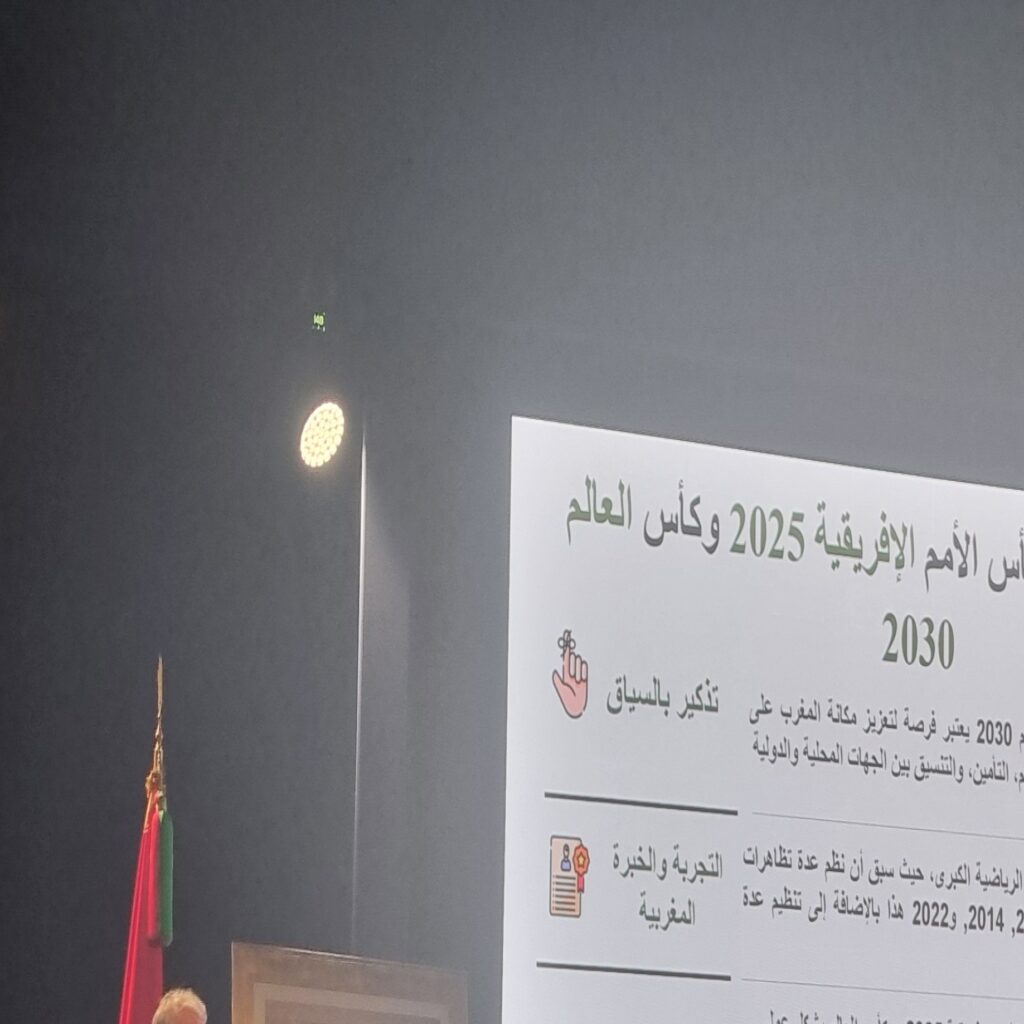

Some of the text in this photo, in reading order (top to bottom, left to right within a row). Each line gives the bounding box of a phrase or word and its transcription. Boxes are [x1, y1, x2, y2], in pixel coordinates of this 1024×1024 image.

[567, 474, 632, 544] العالم
[642, 480, 721, 555] وكأس
[729, 503, 805, 562] 2025
[814, 501, 914, 582] الإفريقية
[924, 520, 977, 592] الأمم
[882, 613, 954, 670] 2030
[607, 674, 718, 720] تذكير بالسياق
[749, 693, 773, 725] على
[780, 698, 821, 726] المغرب
[827, 698, 857, 725] مكانة
[862, 709, 898, 735] لتعزيز
[903, 707, 936, 741] فرصة
[942, 718, 970, 743] يعتبر
[976, 719, 1012, 746] 2030
[753, 730, 799, 767] والدولية
[803, 736, 843, 767] المحلية
[848, 746, 887, 775] الجهات
[891, 754, 910, 778] بين
[914, 754, 964, 784] والتنسيق
[969, 755, 1009, 786] التأمين،
[613, 843, 722, 884] التجربة والخبرة
[743, 844, 792, 873] تظاهرات
[798, 849, 819, 870] عدة
[824, 849, 845, 882] نظم
[850, 849, 863, 882] أن
[868, 861, 894, 886] سبق
[899, 858, 924, 886] حيث
[930, 863, 970, 890] الكبرى،
[975, 867, 1022, 896] الرياضية
[639, 890, 695, 931] المغربية
[743, 885, 764, 906] عدة
[772, 886, 802, 918] تنظيم
[808, 892, 826, 922] إلى
[833, 889, 880, 924] بالإضافة
[888, 894, 904, 920] هذا
